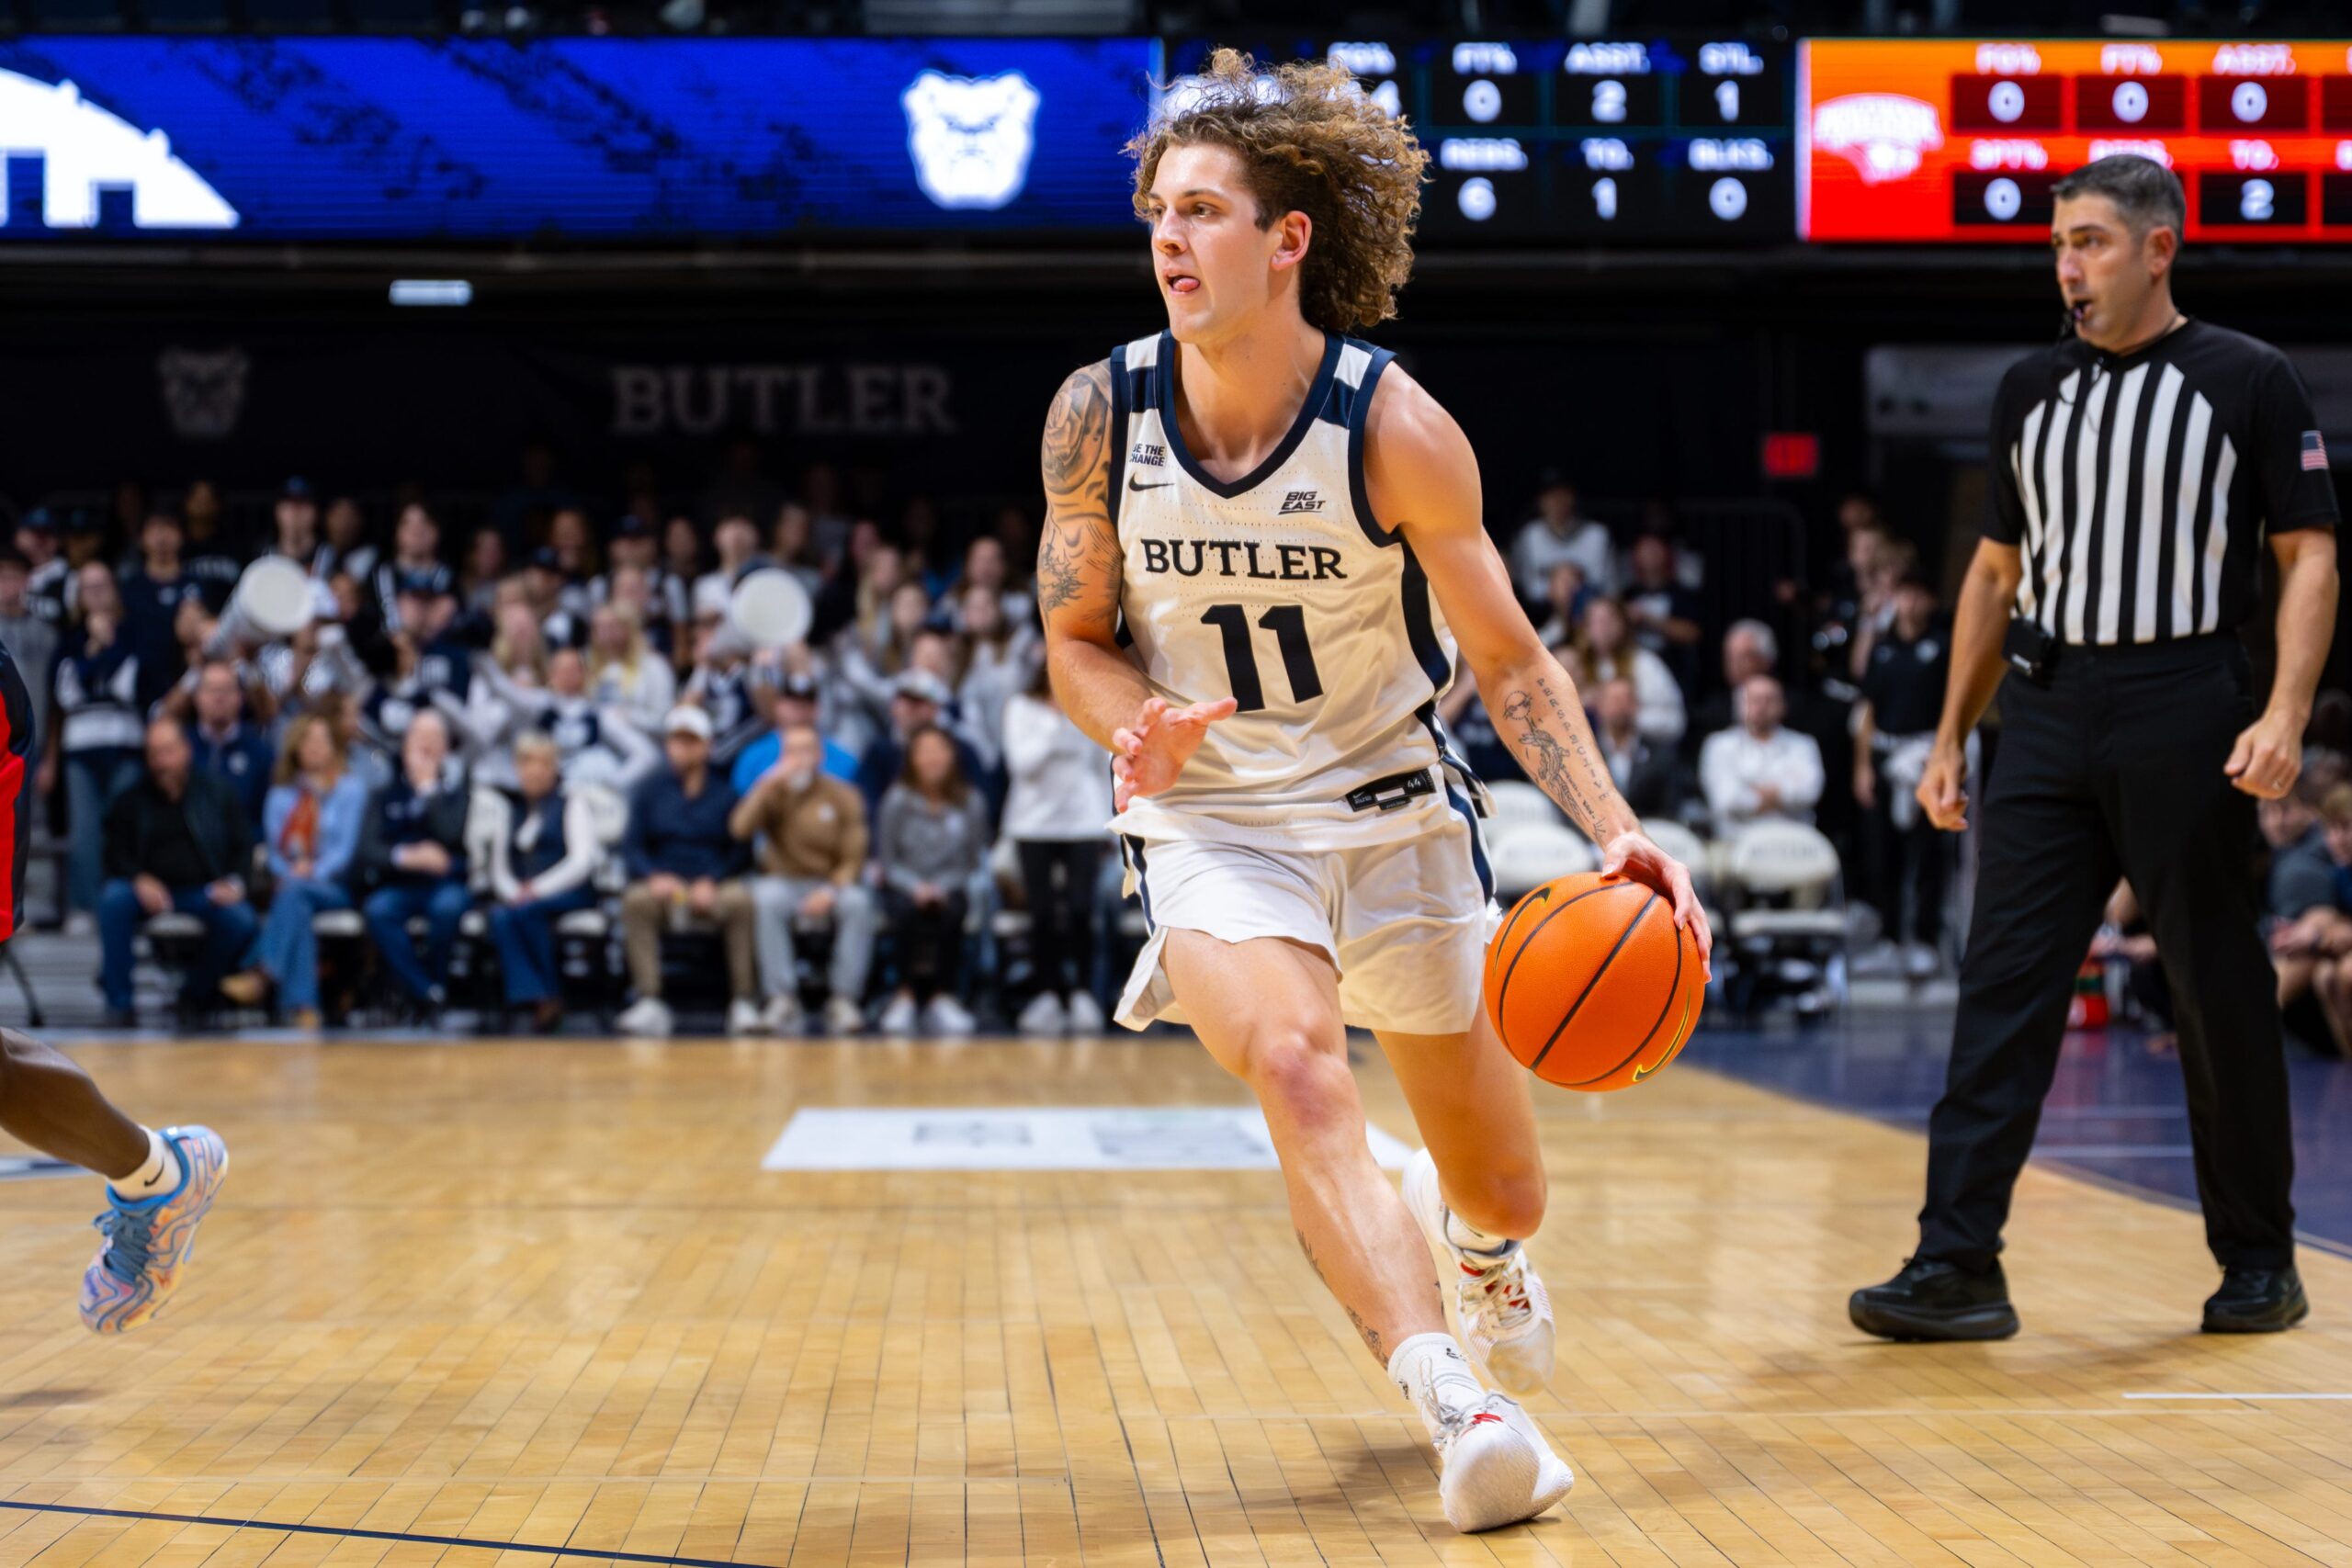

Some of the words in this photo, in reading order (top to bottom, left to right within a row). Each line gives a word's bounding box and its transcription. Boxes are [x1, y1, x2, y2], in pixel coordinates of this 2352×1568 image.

[1463, 79, 1501, 122] 0
[1591, 79, 1627, 122] 2
[1714, 80, 1739, 121] 1
[1988, 81, 2025, 122] 0
[2112, 81, 2148, 122] 0
[2232, 81, 2267, 122] 0
[1458, 177, 1497, 220] 6
[1592, 177, 1617, 220] 1
[1709, 177, 1747, 220] 0
[1984, 177, 2021, 220] 0
[2240, 178, 2275, 220] 2
[614, 368, 955, 434] BUTLER
[1145, 445, 1165, 456] THE
[1281, 501, 1326, 510] EAST
[1286, 491, 1317, 501] BIG
[1140, 538, 1348, 580] BUTLER
[1201, 604, 1324, 713] 11
